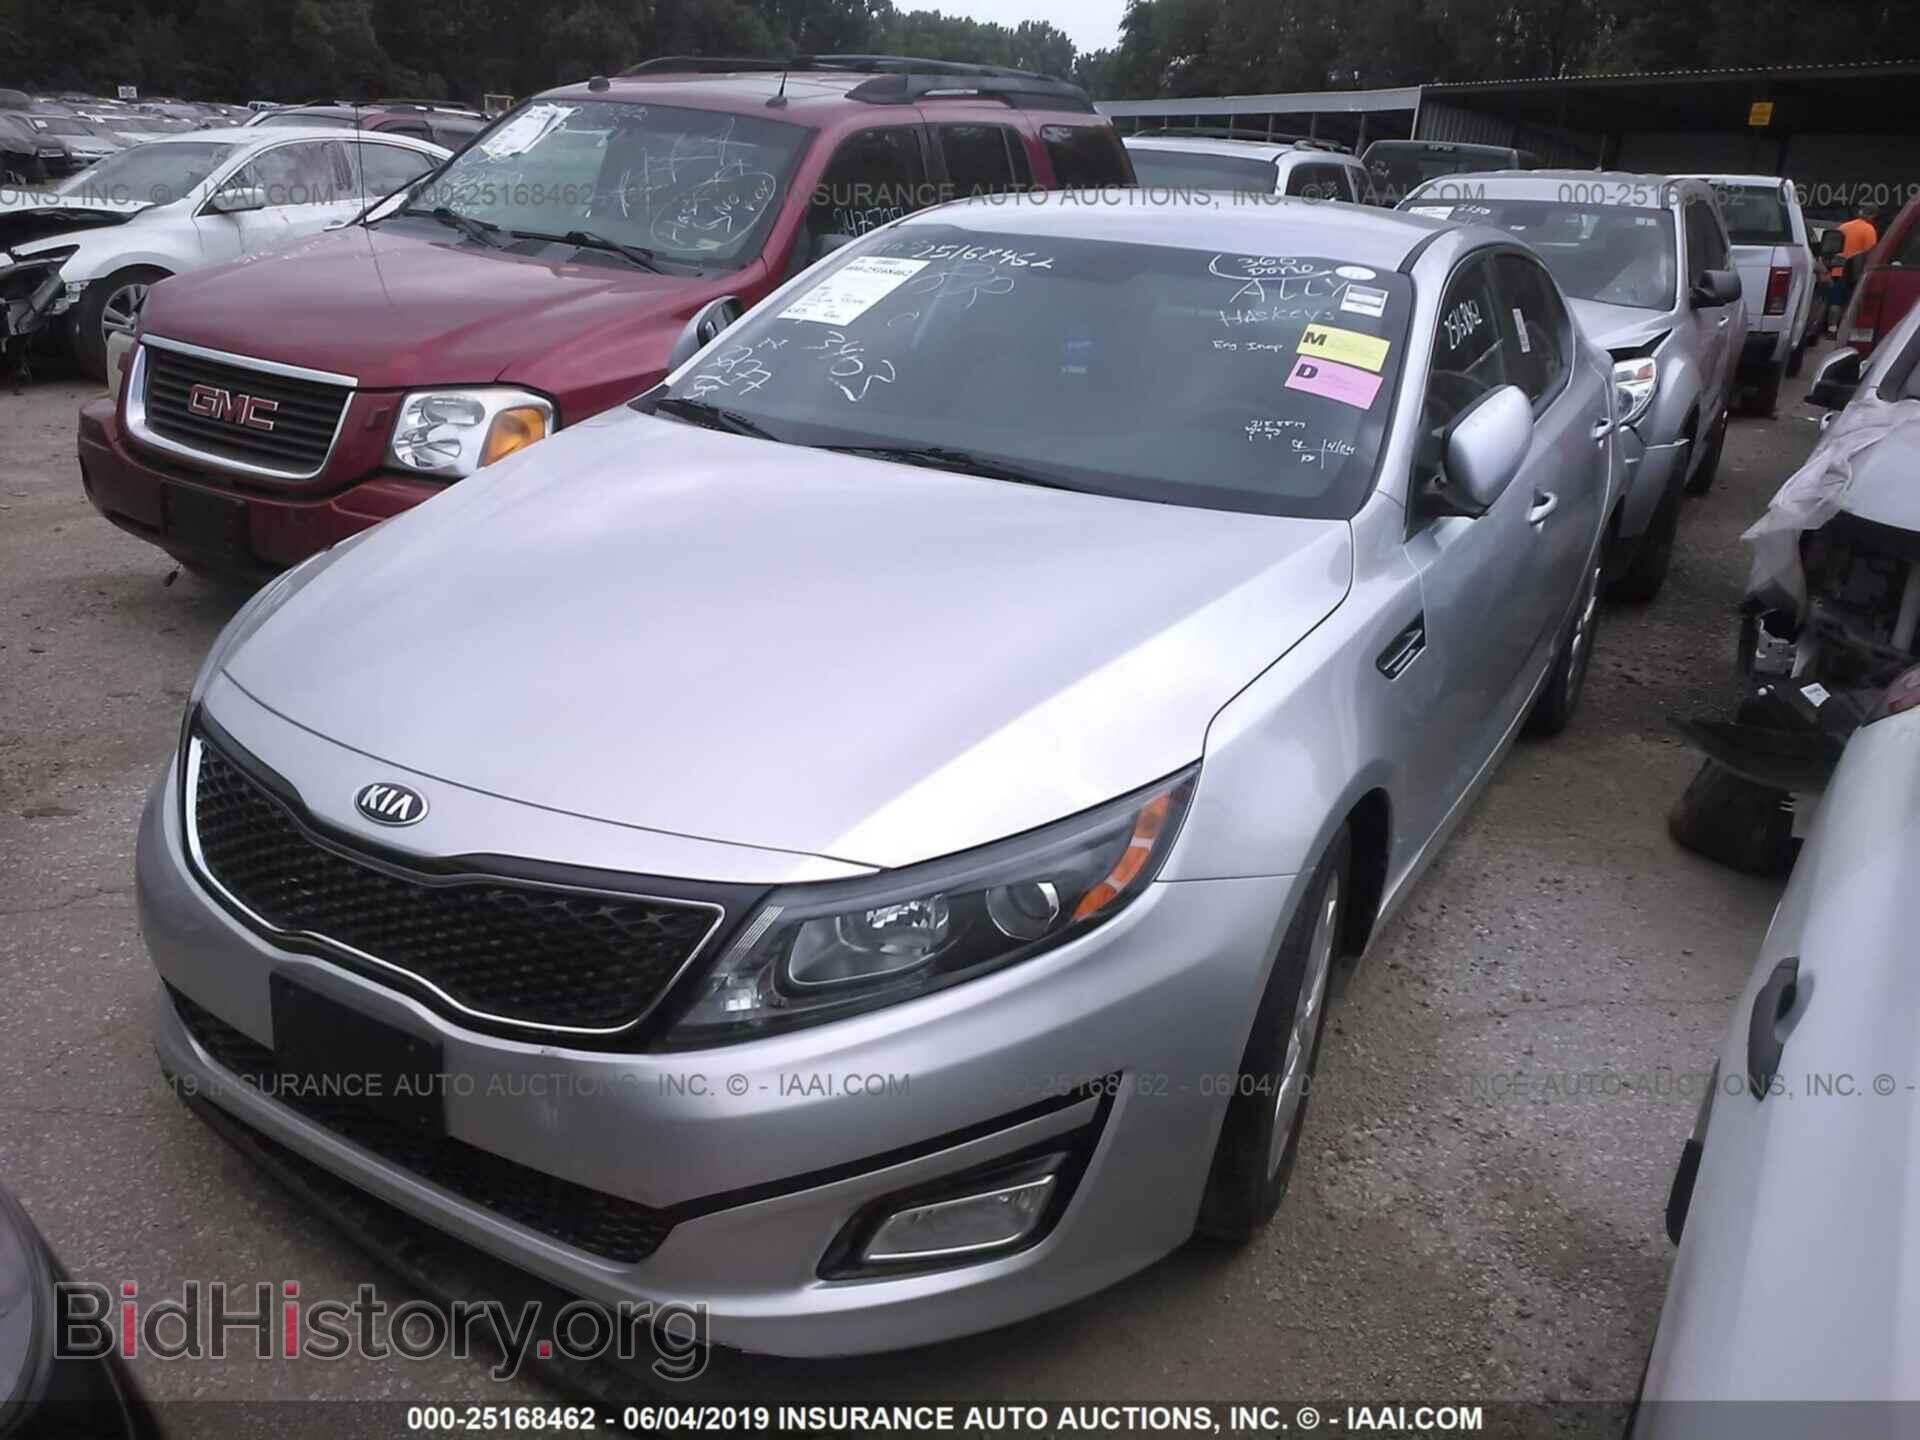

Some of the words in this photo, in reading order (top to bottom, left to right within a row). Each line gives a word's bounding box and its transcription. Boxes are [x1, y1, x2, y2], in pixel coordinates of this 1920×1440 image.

[1303, 332, 1327, 346] M
[1296, 364, 1318, 379] D
[188, 384, 279, 431] GMC
[361, 785, 414, 820] KIA
